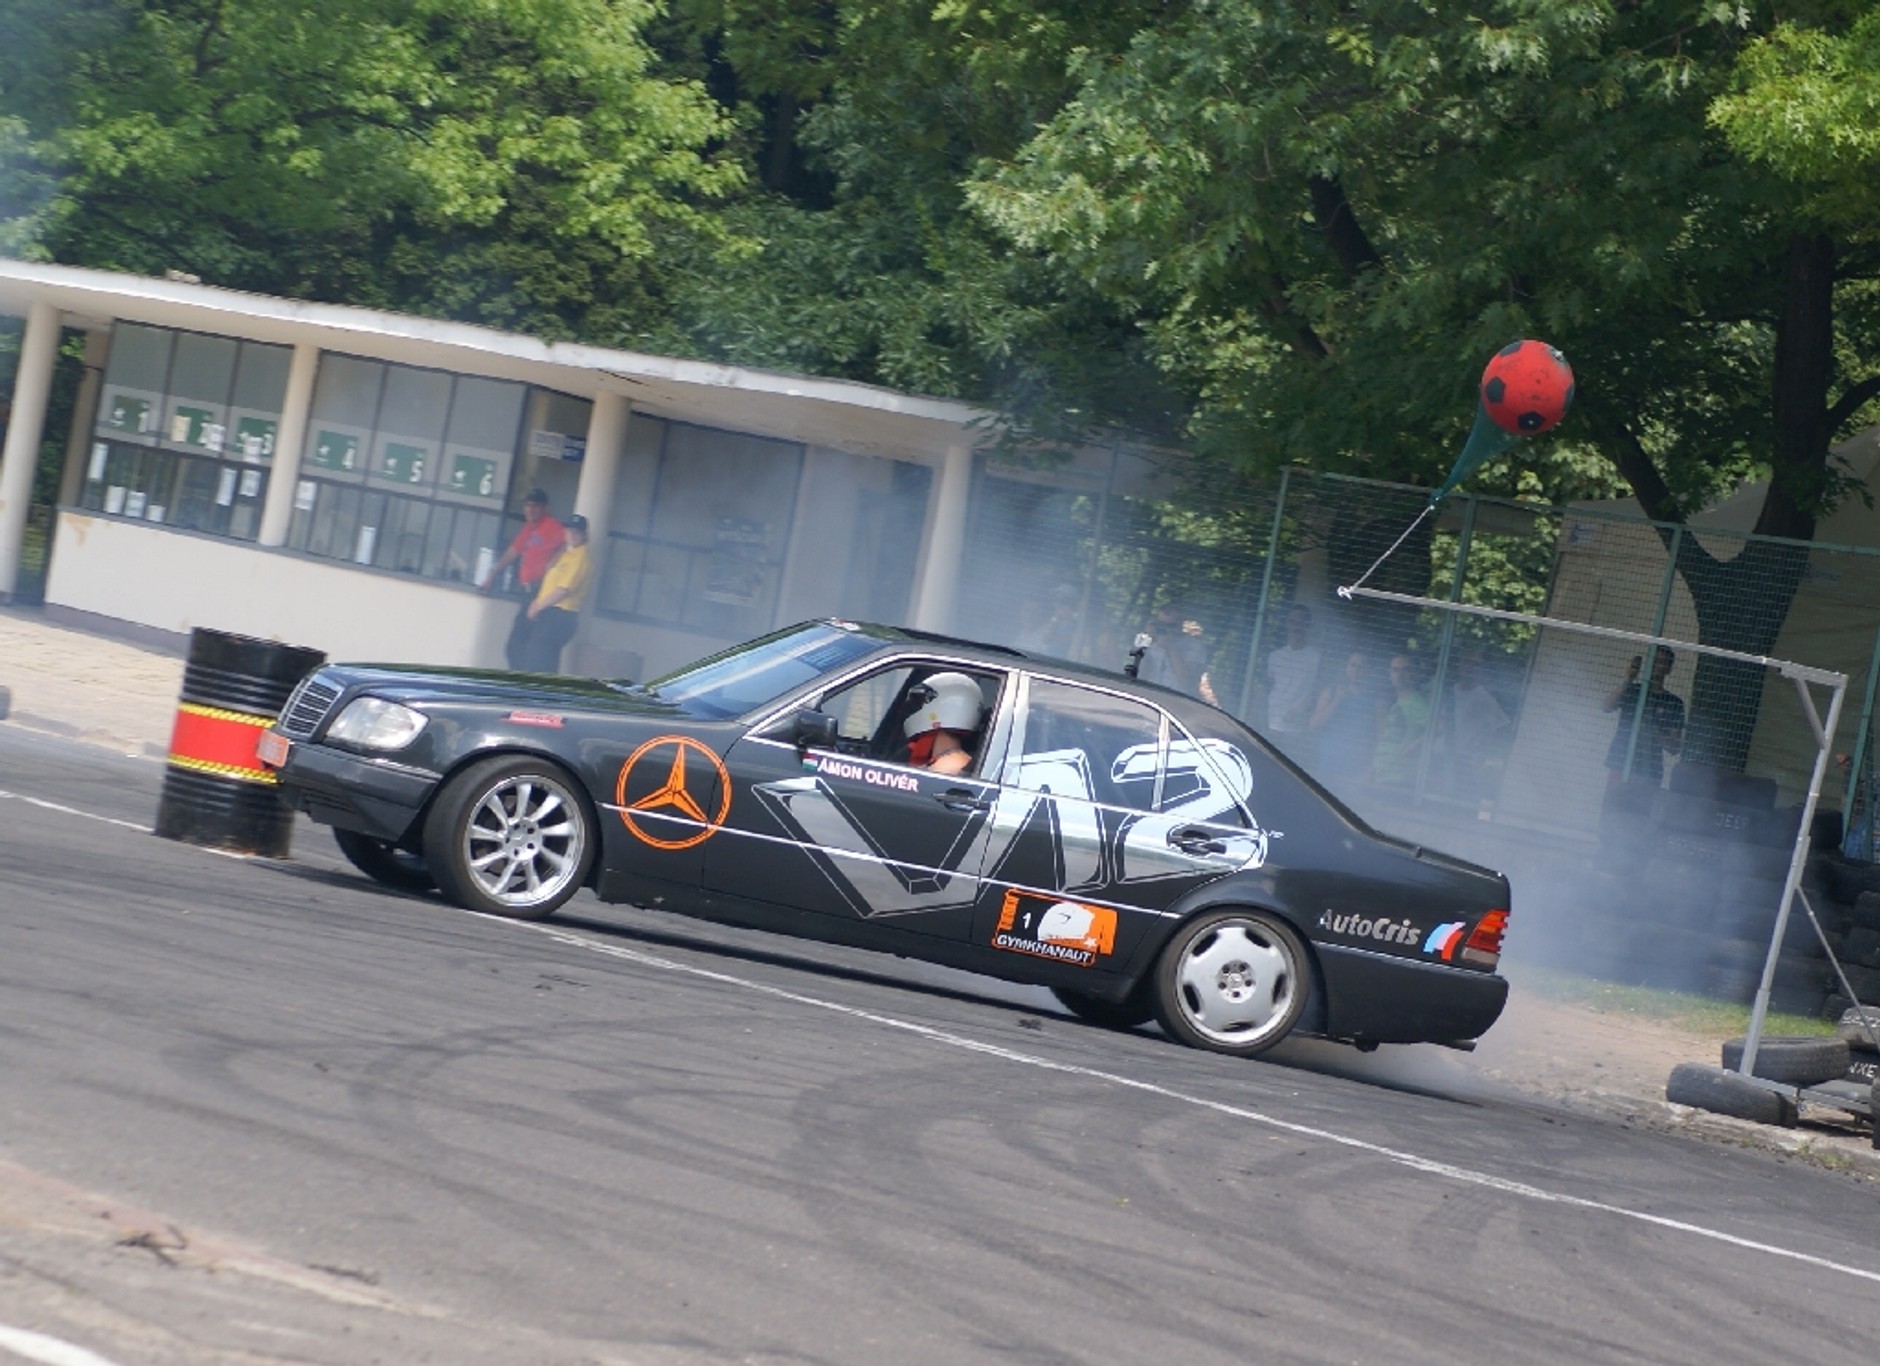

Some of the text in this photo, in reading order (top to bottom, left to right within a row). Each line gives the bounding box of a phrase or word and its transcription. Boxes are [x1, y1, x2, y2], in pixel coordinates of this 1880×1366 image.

[341, 447, 356, 471] 4
[409, 459, 424, 483] 5
[479, 470, 494, 496] 6
[817, 757, 920, 793] ÁMON OLIVÉR
[1022, 911, 1032, 930] 1
[1315, 908, 1422, 946] AutoCris
[996, 934, 1092, 964] GYMKHANAUT
